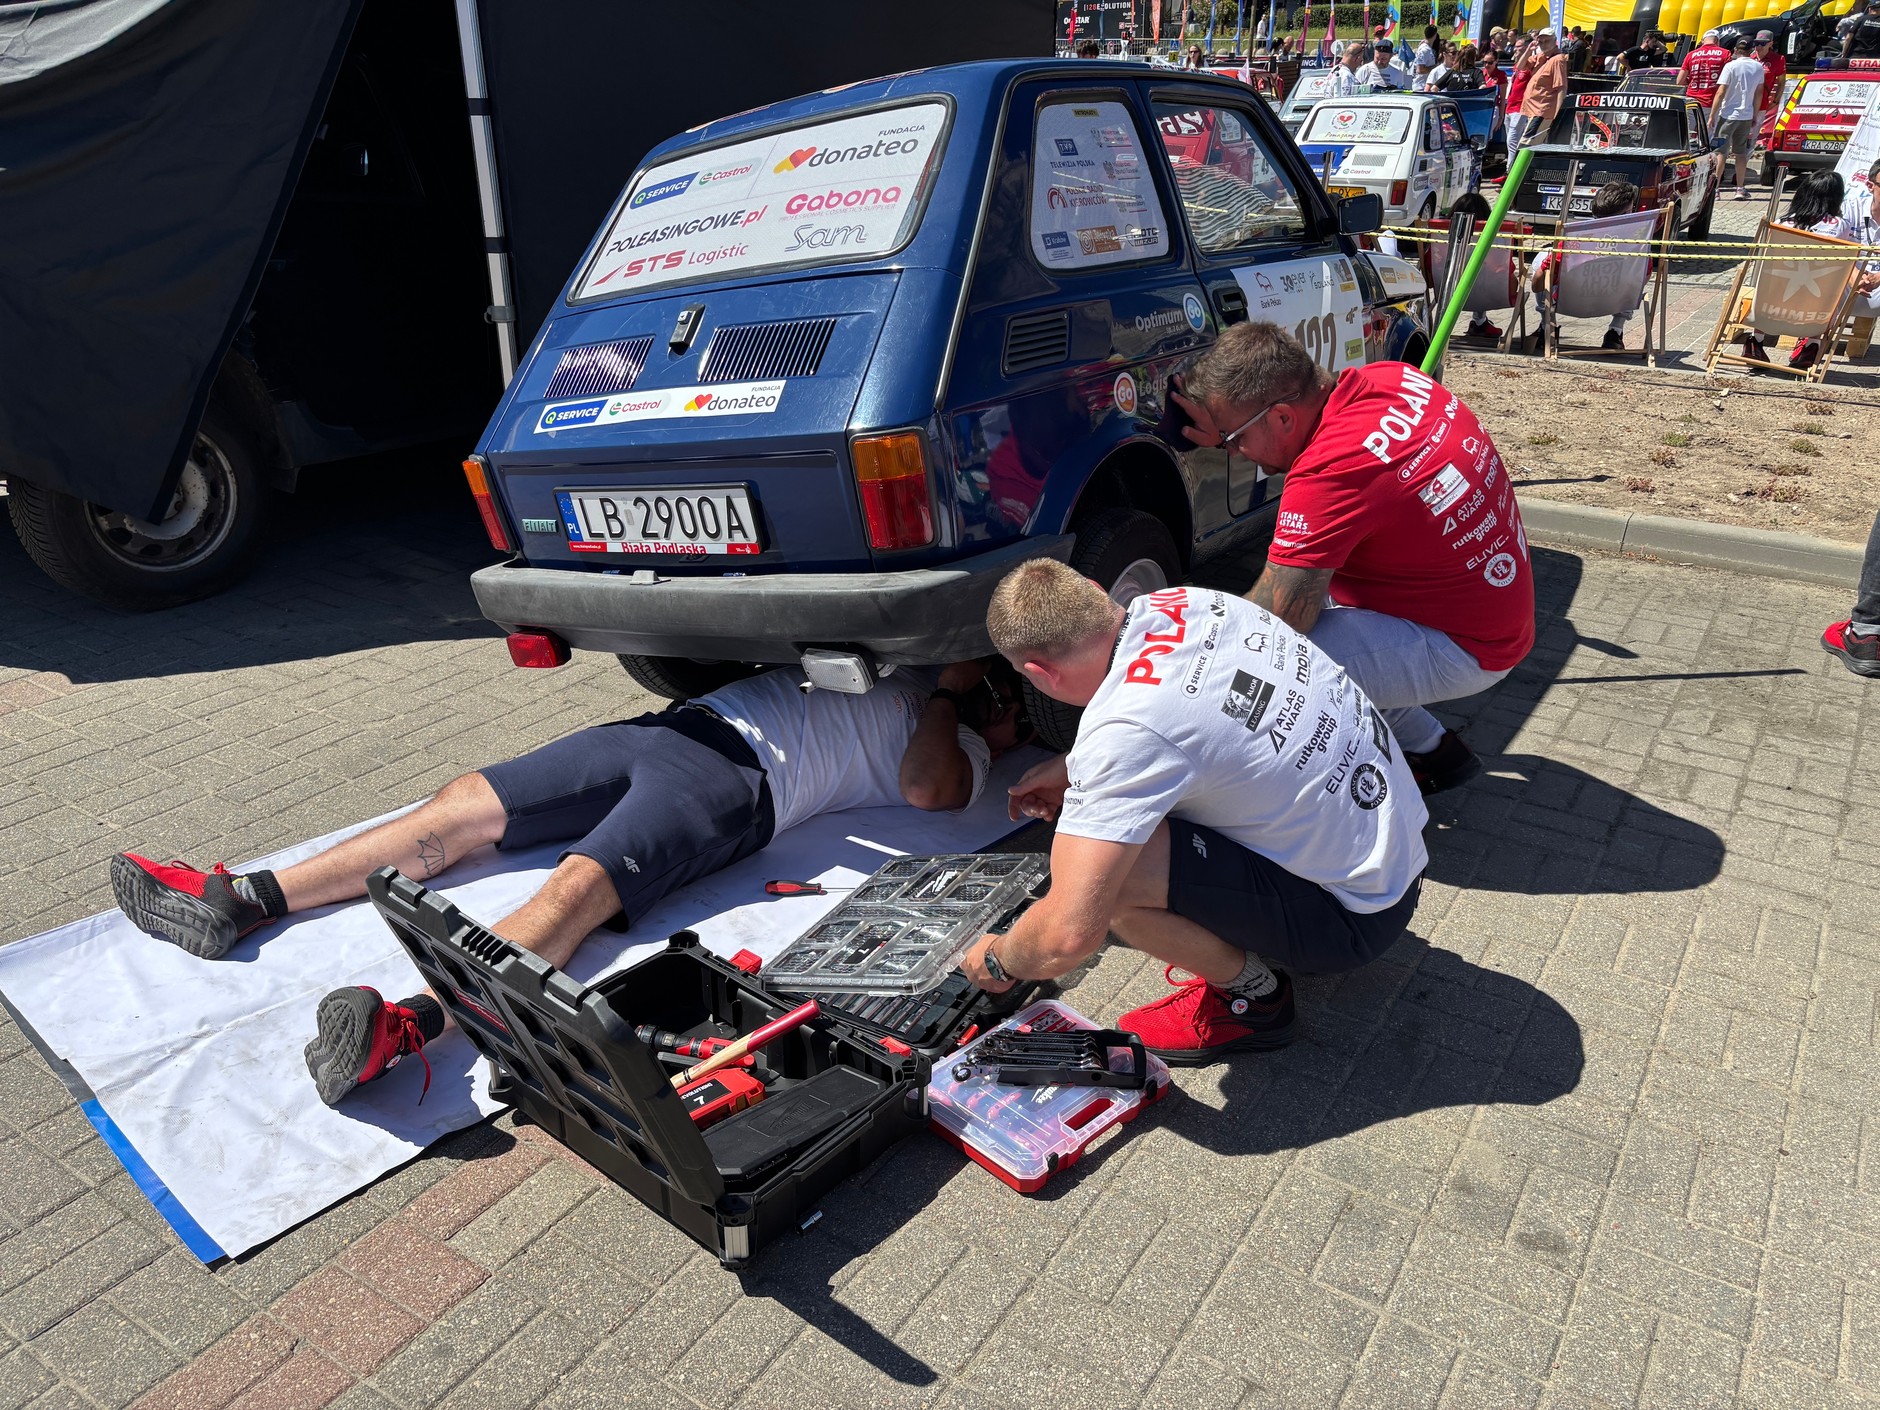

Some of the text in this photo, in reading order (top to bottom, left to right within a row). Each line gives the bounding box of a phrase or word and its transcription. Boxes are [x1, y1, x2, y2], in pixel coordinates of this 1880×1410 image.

[1692, 49, 1723, 59] POLAND
[1575, 94, 1671, 110] [126EVOLUTION]
[878, 124, 925, 138] FUNDACJA
[808, 138, 919, 168] donateo
[646, 179, 690, 200] SERVICE
[712, 164, 753, 182] Castrol
[785, 186, 902, 215] Gabona
[825, 206, 862, 217] COSMETICS
[862, 203, 896, 213] SUPPLIER
[605, 204, 769, 257] POLEASINGOWE.pl
[784, 223, 866, 252] Sam
[623, 243, 749, 278] STS Logistic
[1135, 310, 1183, 332] Optimum
[1187, 304, 1201, 319] Go
[751, 384, 781, 393] FUNDACJA
[1117, 388, 1133, 403] Go
[557, 406, 600, 421] SERVICE
[622, 399, 663, 413] Castrol
[708, 393, 777, 412] donateo
[1362, 366, 1434, 465] POLAN
[1408, 445, 1432, 471] SERVICE
[1280, 511, 1304, 522] STARS
[1457, 488, 1483, 518] ATLAS
[1459, 494, 1486, 522] WARD
[522, 519, 557, 533] FIAT
[567, 522, 580, 535] PL
[578, 494, 750, 541] LB 2900A
[1452, 508, 1495, 550] rutkowski
[1476, 515, 1498, 542] group
[621, 542, 707, 556] Biała Podlaska
[1274, 635, 1287, 672] Bank Pekao
[1295, 643, 1310, 685] moya
[1191, 655, 1208, 685] SERVICE
[1246, 677, 1259, 698] ALIOR
[1249, 700, 1266, 728] LEASING
[1275, 689, 1297, 728] ATLAS
[1283, 694, 1306, 732] WARD
[1295, 710, 1331, 771] rutkowski
[1316, 718, 1338, 754] group
[1370, 783, 1388, 809] POLSKA
